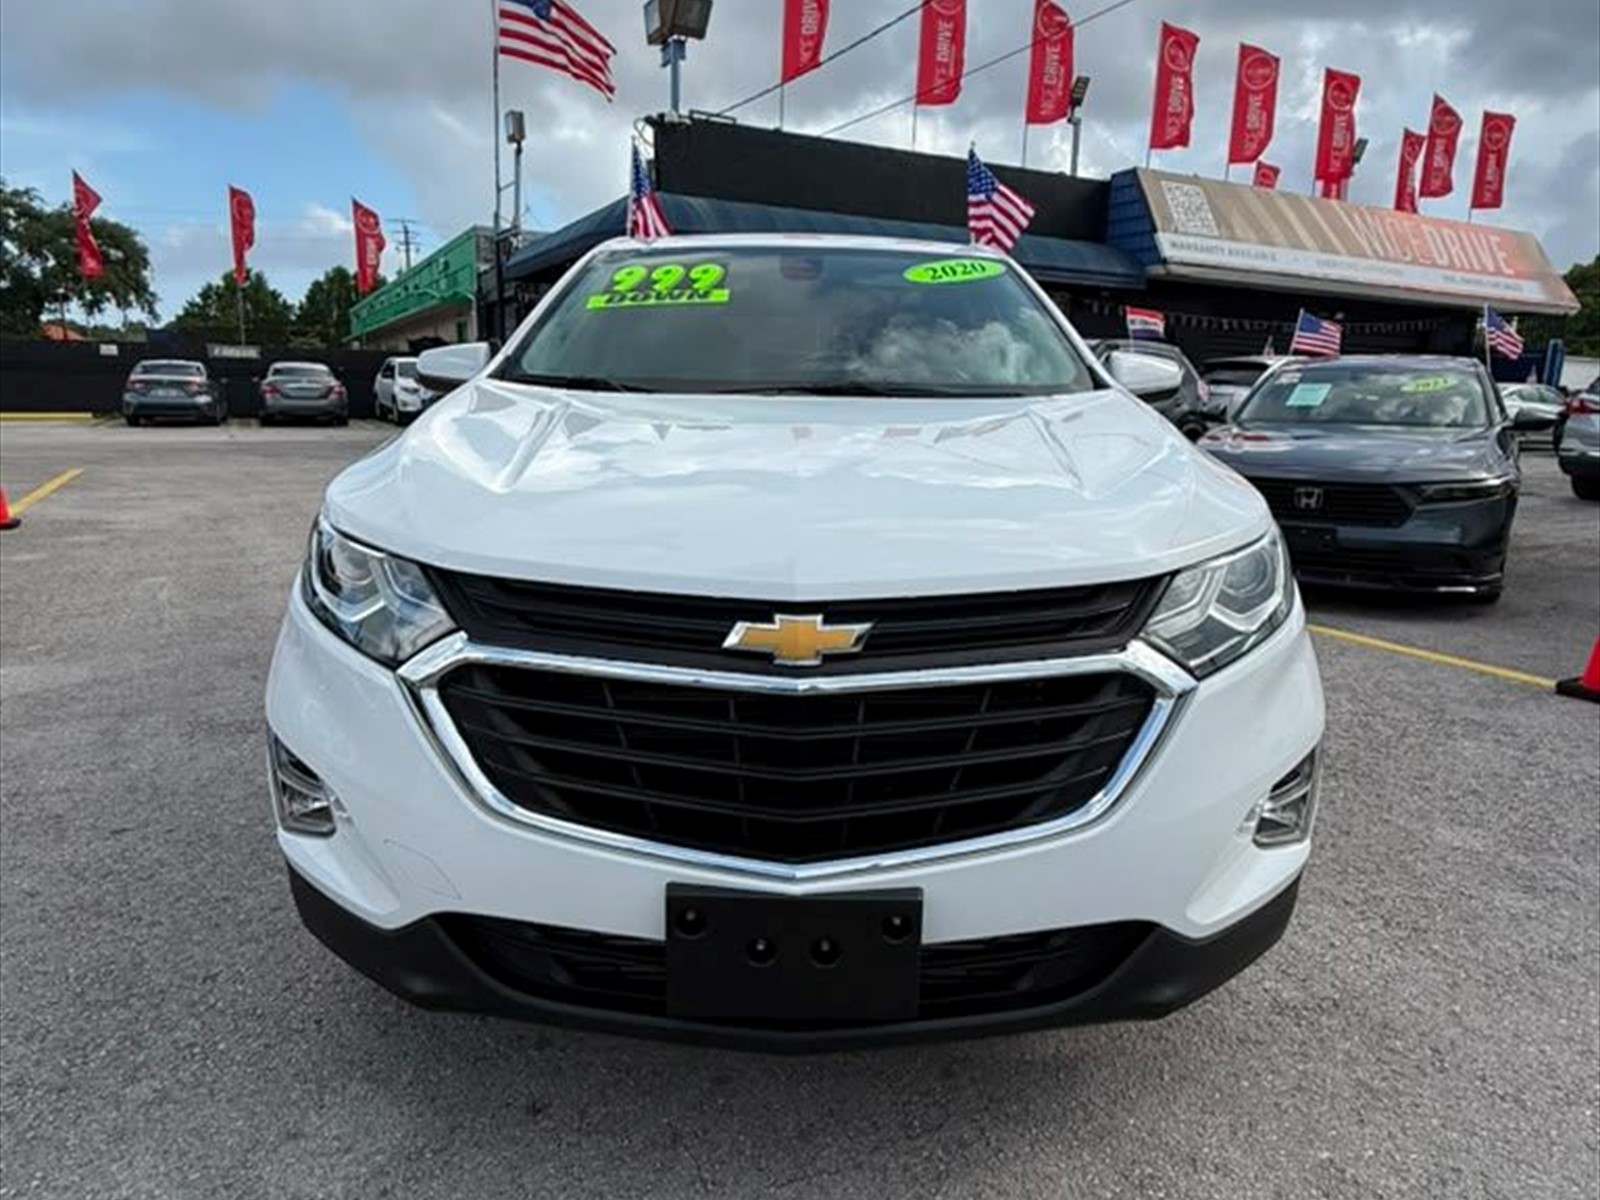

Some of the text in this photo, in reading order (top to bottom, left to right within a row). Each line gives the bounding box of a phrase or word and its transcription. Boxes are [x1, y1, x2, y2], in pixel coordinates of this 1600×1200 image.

[936, 19, 955, 62] DRIVE
[1043, 41, 1061, 84] DRIVE
[1423, 220, 1516, 276] DRIVE
[611, 263, 726, 292] 999
[924, 261, 987, 281] 2020
[603, 287, 713, 306] DOWN
